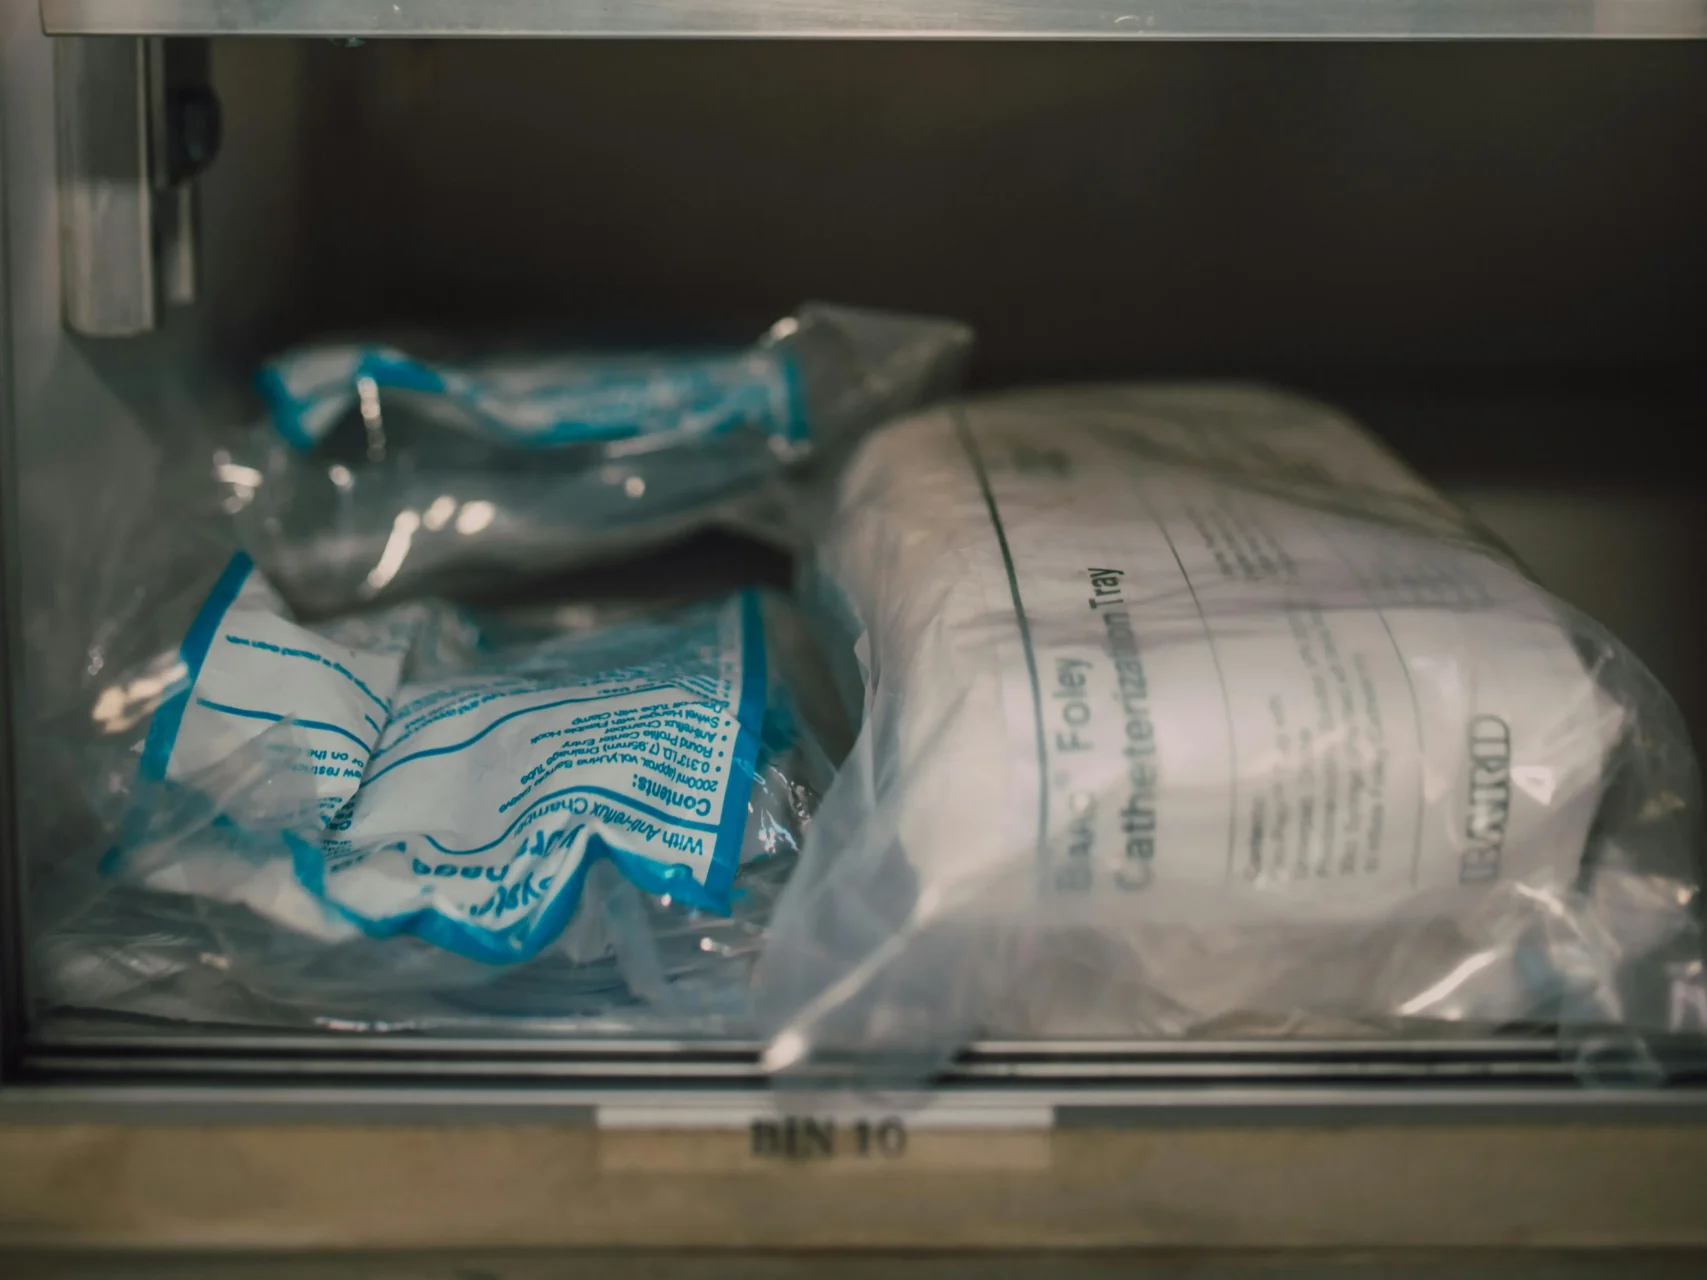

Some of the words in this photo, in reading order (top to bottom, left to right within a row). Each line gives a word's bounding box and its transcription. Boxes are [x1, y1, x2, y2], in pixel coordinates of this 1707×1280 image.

[1086, 567, 1125, 610] Tray
[639, 709, 682, 721] Hanger
[1052, 658, 1092, 754] Foley
[604, 720, 661, 734] Chamber
[685, 709, 719, 728] Swivel
[562, 738, 595, 749] Entry
[599, 731, 640, 743] Center
[643, 730, 677, 742] Profile
[331, 750, 349, 761] on
[546, 746, 599, 765] Drainage
[679, 737, 713, 758] Round
[1101, 612, 1156, 893] Catheterization
[520, 763, 545, 785] Tube
[677, 772, 718, 792] 2000ml
[632, 773, 711, 817] Contents:
[587, 801, 661, 842] Anti-reflux
[662, 830, 703, 856] With
